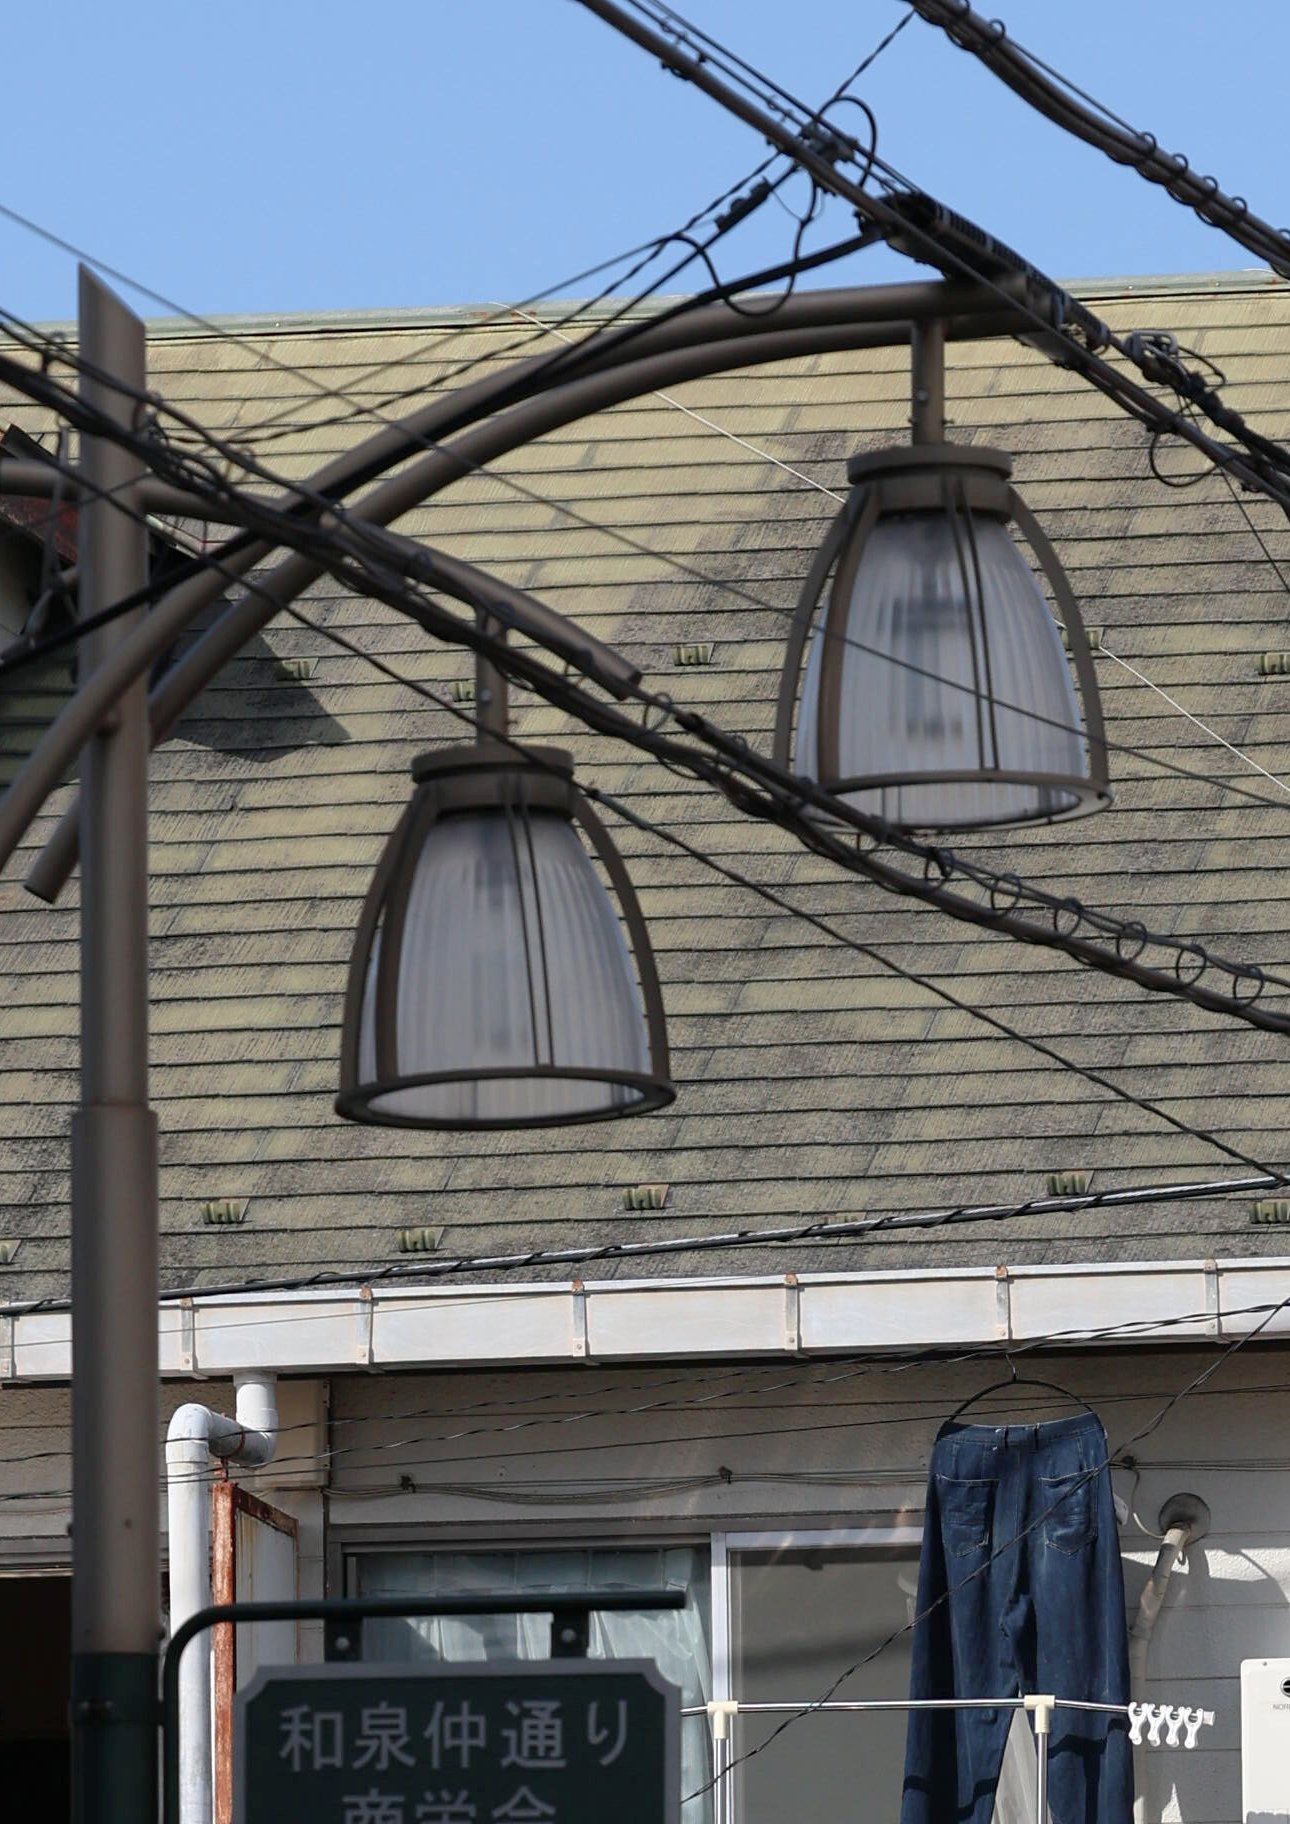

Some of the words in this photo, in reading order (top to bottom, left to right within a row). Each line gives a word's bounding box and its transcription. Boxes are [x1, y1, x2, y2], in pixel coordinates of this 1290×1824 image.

[279, 1700, 627, 1773] 和泉仲通り
